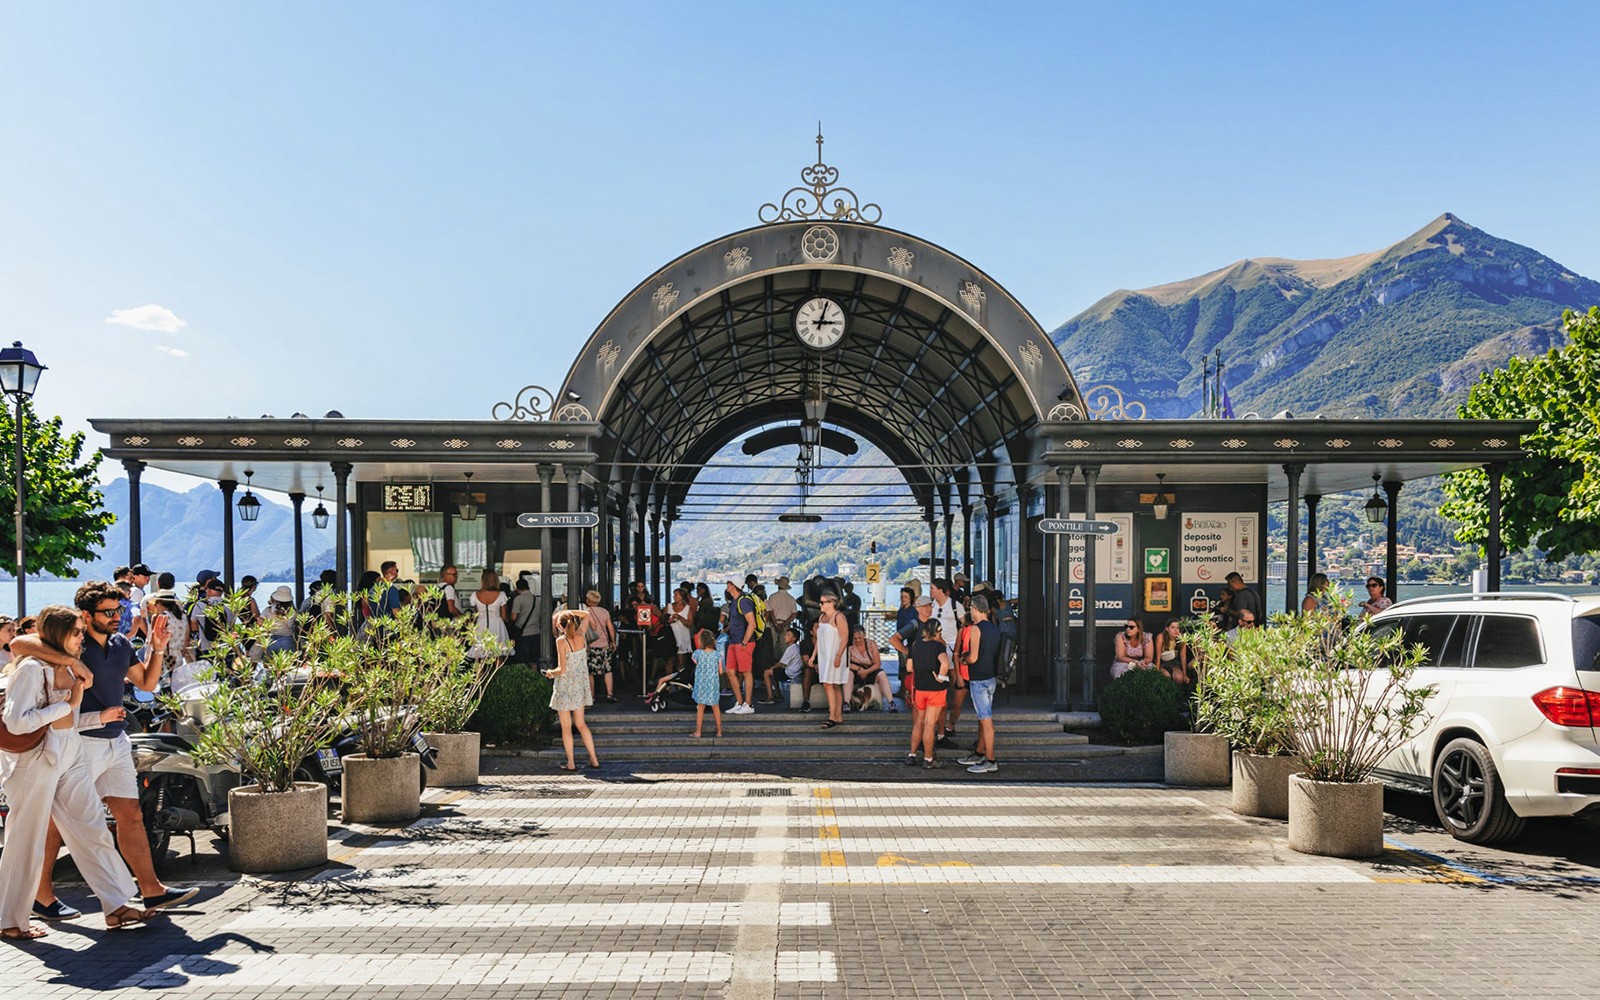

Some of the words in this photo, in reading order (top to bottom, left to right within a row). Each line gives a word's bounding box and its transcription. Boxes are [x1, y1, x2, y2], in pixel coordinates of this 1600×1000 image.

[544, 516, 580, 524] PONTILE
[585, 516, 590, 524] 3
[1048, 522, 1084, 531] PONTILE
[1184, 533, 1221, 541] deposito
[1184, 544, 1217, 553] bagagli
[1184, 555, 1234, 563] automatico
[869, 568, 877, 581] 2
[1095, 600, 1123, 609] enza
[1193, 600, 1207, 609] es
